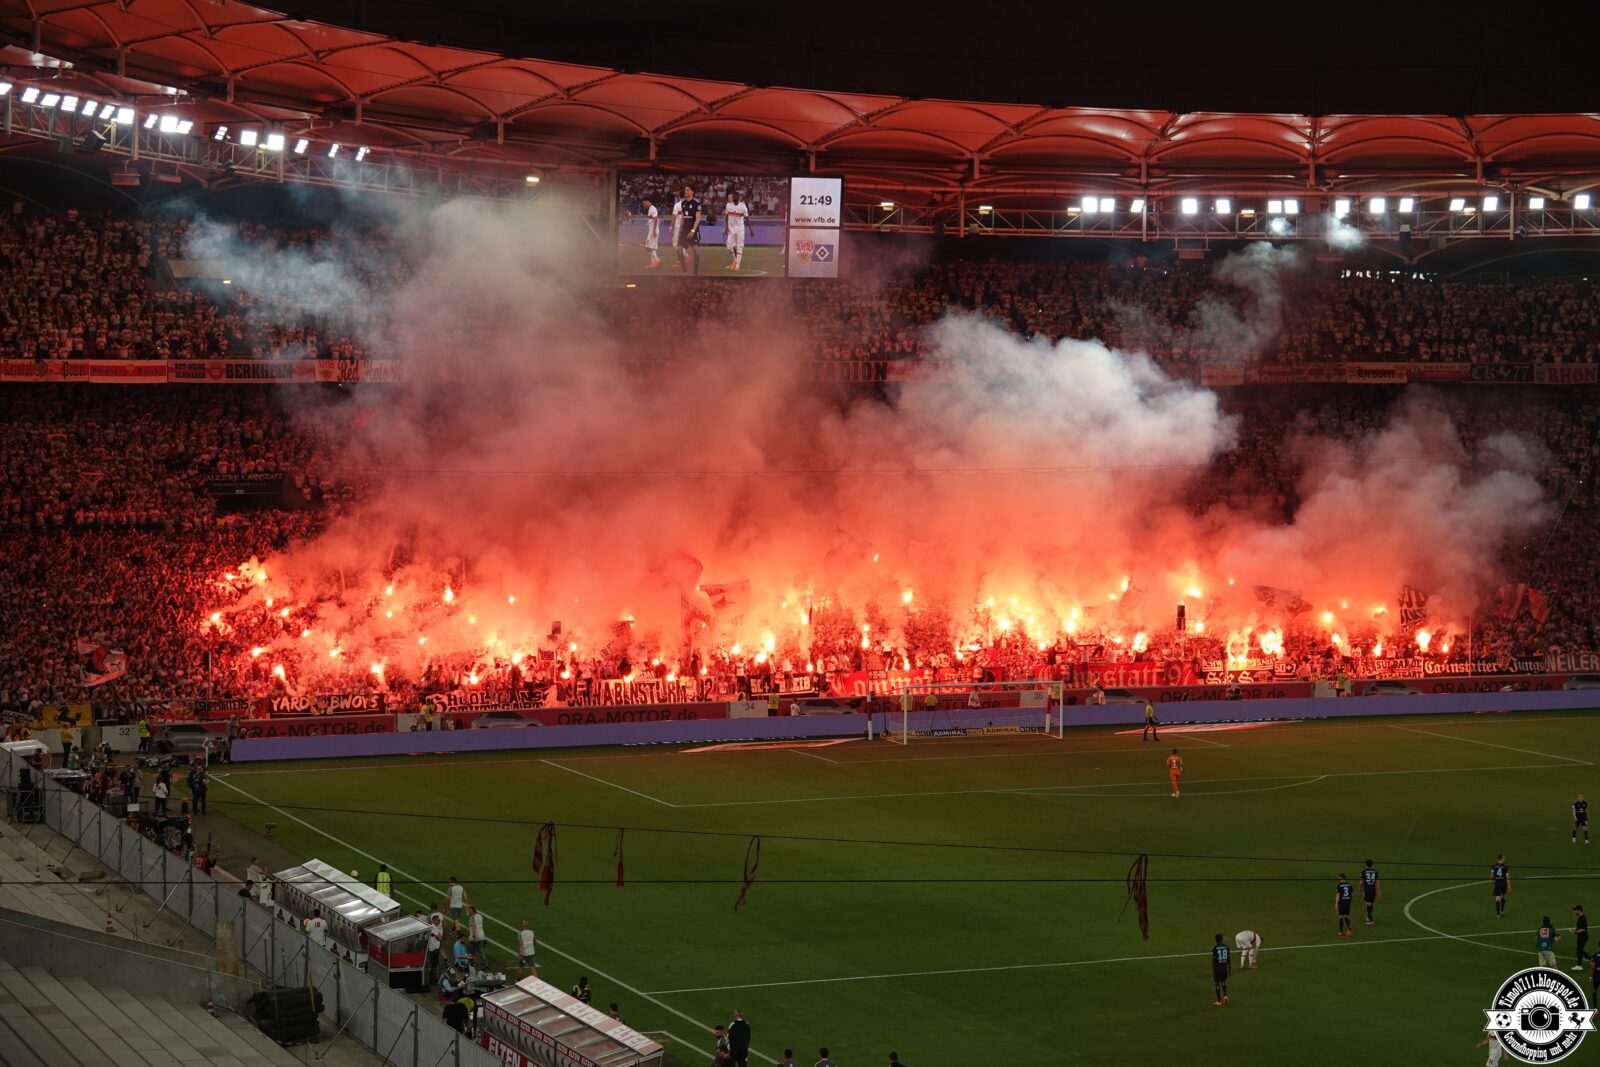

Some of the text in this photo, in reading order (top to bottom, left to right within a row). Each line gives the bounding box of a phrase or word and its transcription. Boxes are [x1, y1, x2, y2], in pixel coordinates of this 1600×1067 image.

[800, 194, 832, 206] 21:49
[225, 363, 292, 379] BERKHEIM
[1508, 657, 1545, 673] Jungs
[271, 695, 378, 712] YARD BWOYS
[744, 703, 754, 711] 34
[557, 708, 698, 725] ORA-MOTOR.de
[119, 728, 130, 737] 32
[253, 721, 386, 739] RA-MOTOR.de
[986, 726, 1020, 734] ADMIRAL
[1343, 886, 1349, 897] 3
[1217, 949, 1228, 961] 18
[488, 1036, 521, 1067] ELTEN
